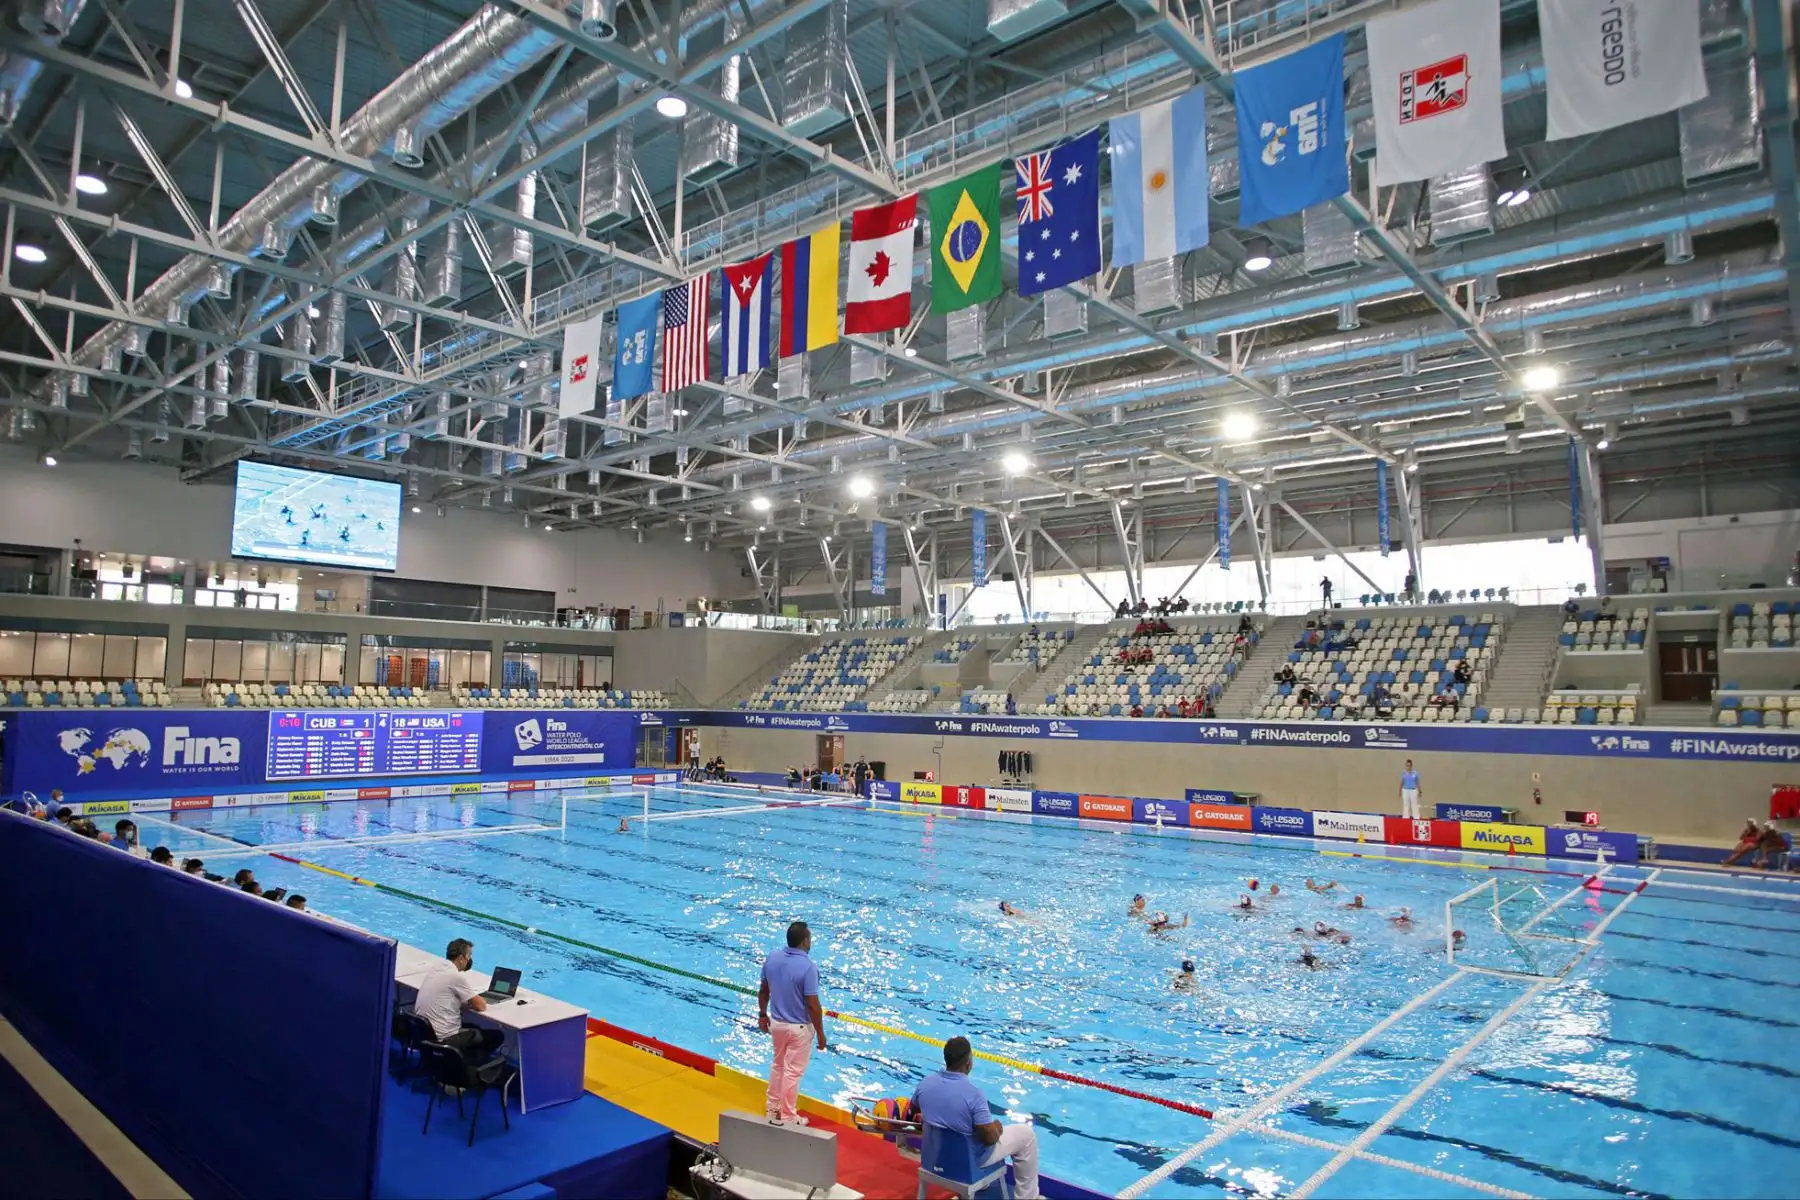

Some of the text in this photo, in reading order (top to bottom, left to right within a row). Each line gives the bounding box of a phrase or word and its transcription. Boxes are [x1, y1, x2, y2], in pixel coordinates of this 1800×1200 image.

[310, 718, 337, 728] CUB
[364, 718, 370, 728] 1
[379, 718, 387, 727] 4
[422, 718, 445, 727] USA
[771, 717, 821, 727] #FINAwaterpolo
[971, 722, 1040, 735] #FINAwaterpolo
[1251, 728, 1351, 744] #FINAwaterpolo
[163, 726, 240, 765] Fina
[1092, 803, 1126, 812] GATORADE
[1205, 812, 1244, 821] GATORADE
[1330, 821, 1380, 833] Malmsten
